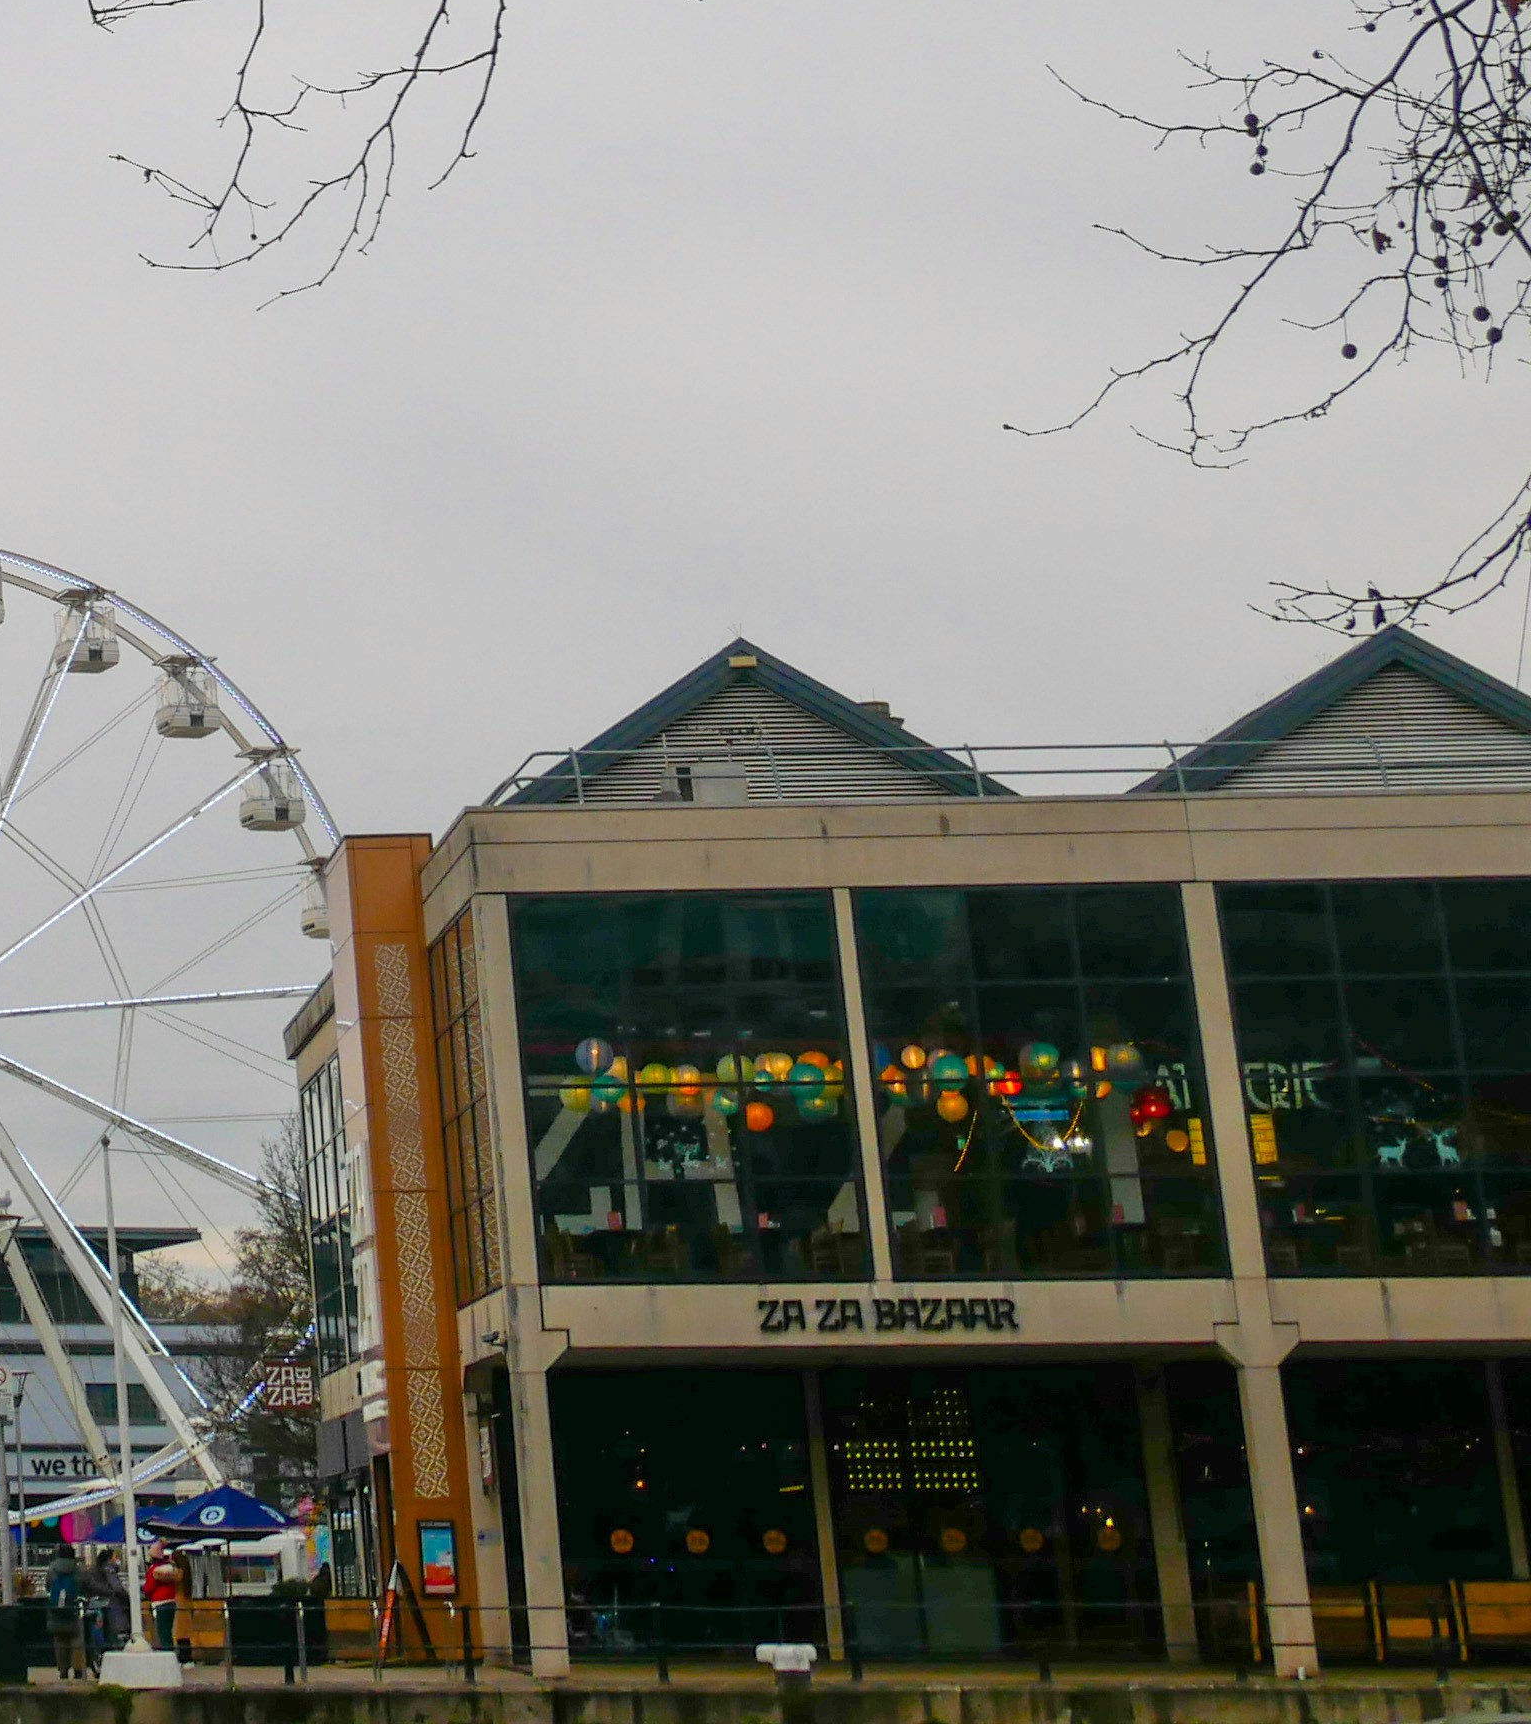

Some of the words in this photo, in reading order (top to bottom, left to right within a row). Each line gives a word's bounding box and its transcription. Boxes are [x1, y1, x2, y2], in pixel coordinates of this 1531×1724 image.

[757, 1298, 807, 1331] ZA
[814, 1298, 864, 1331] ZA
[871, 1297, 1020, 1331] BAZAAR
[266, 1366, 296, 1386] ZA
[295, 1366, 313, 1406] BAR
[267, 1386, 297, 1406] ZA
[30, 1458, 67, 1476] we
